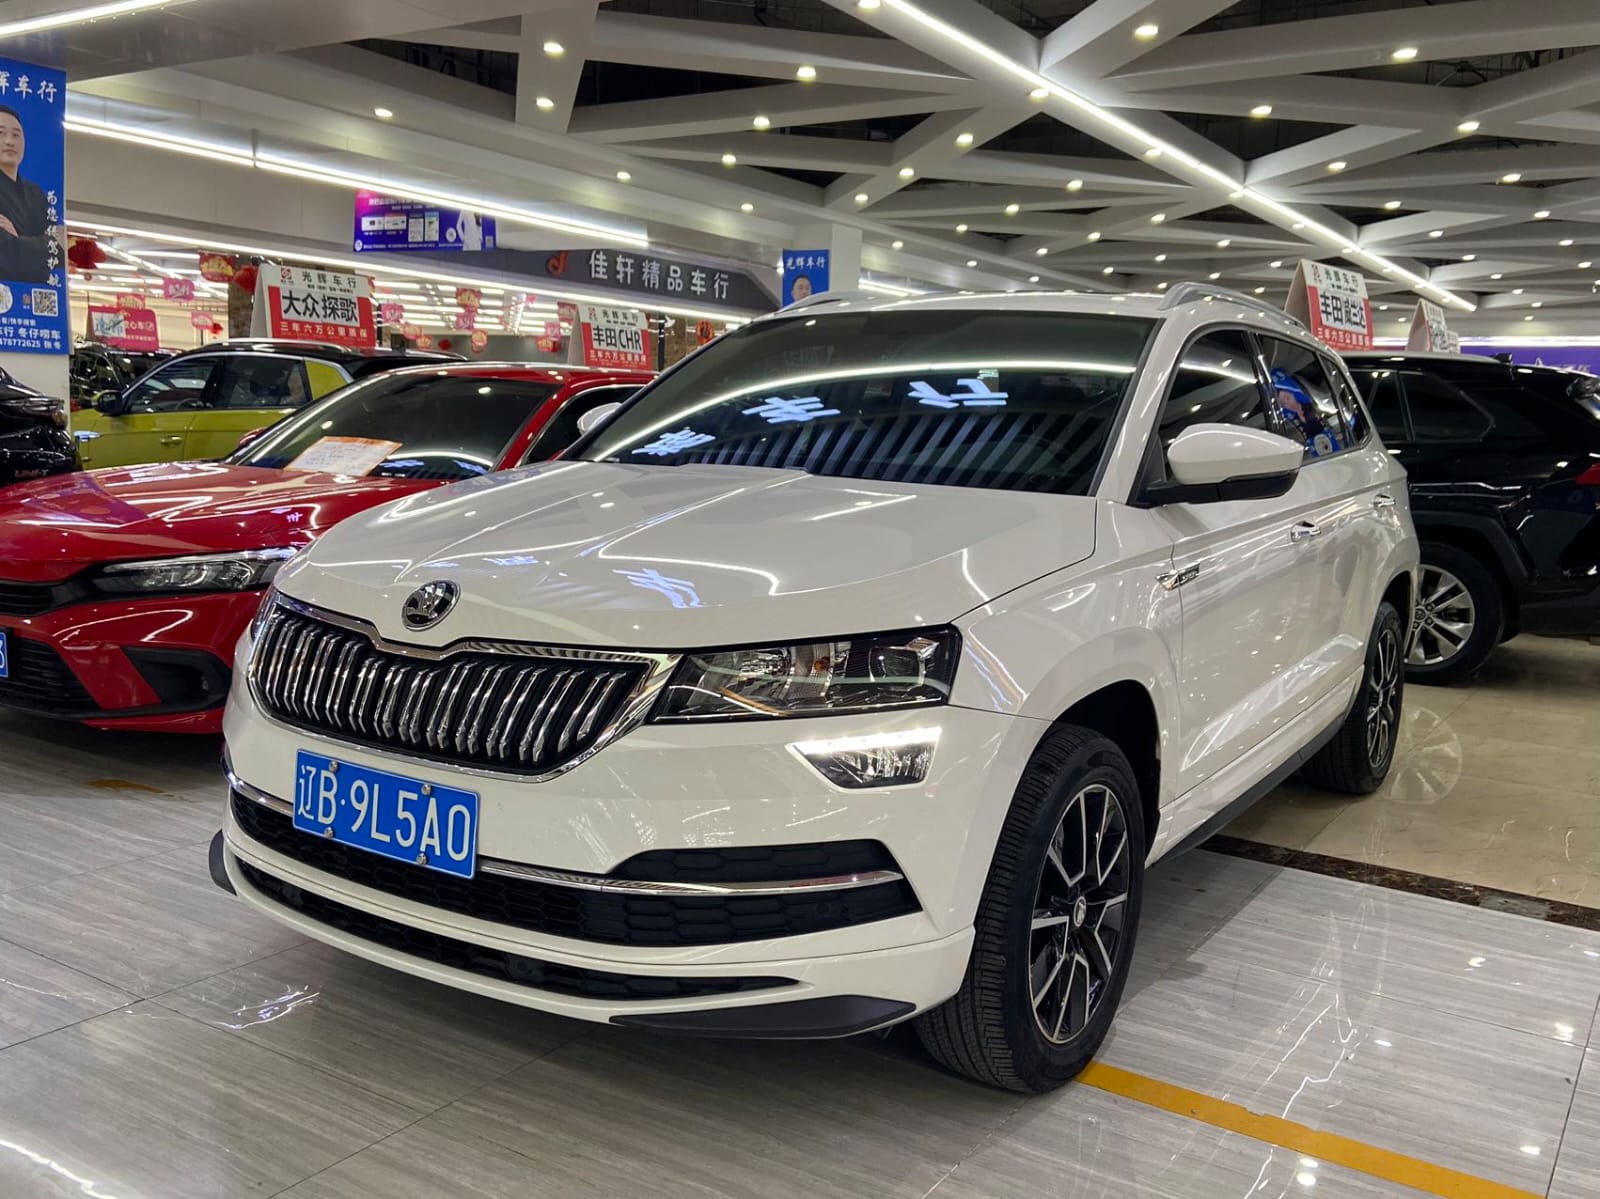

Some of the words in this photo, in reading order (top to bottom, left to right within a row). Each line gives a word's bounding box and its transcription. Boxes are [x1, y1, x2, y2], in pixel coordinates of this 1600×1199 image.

[302, 271, 357, 288] 光辉车行
[589, 250, 729, 299] 佳轩精品车行
[282, 290, 358, 322] 大众探歌
[593, 324, 642, 351] 丰田CHR
